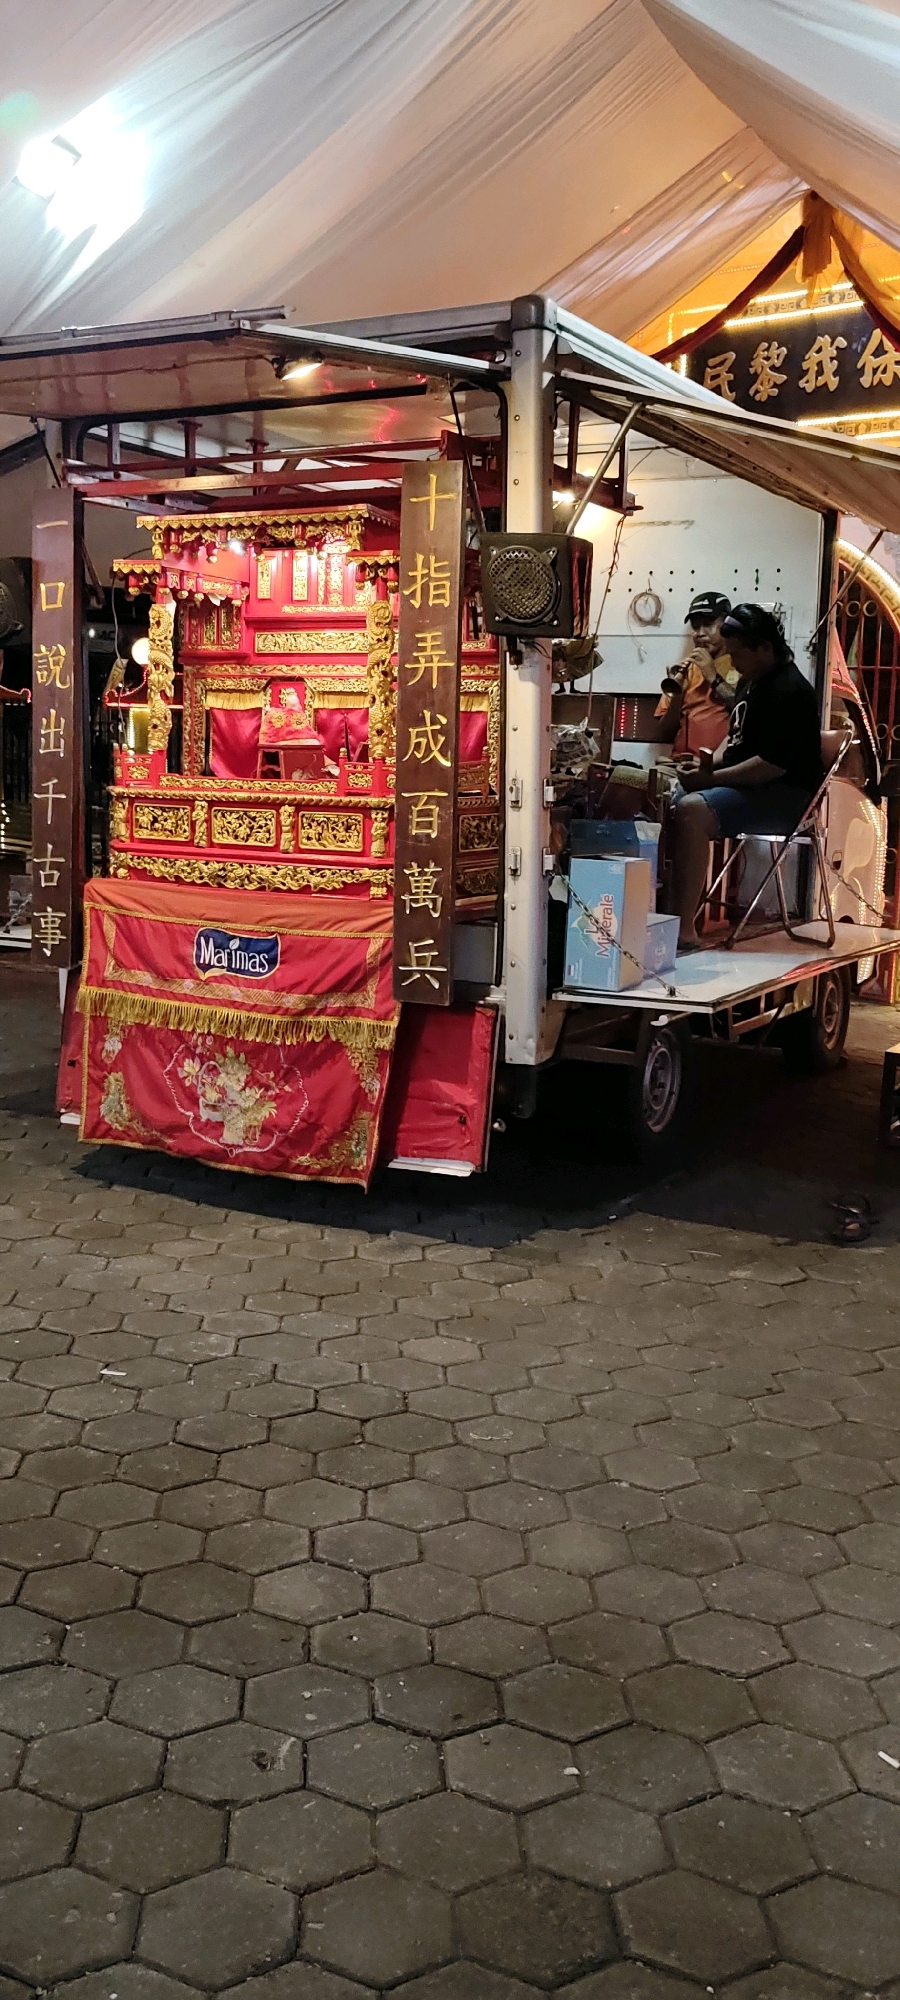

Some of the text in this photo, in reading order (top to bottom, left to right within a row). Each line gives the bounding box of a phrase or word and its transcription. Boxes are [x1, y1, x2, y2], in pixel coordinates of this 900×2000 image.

[34, 521, 70, 957] 一口說出千古事
[398, 474, 457, 989] 十指弄成百萬兵
[200, 937, 268, 972] Marimas
